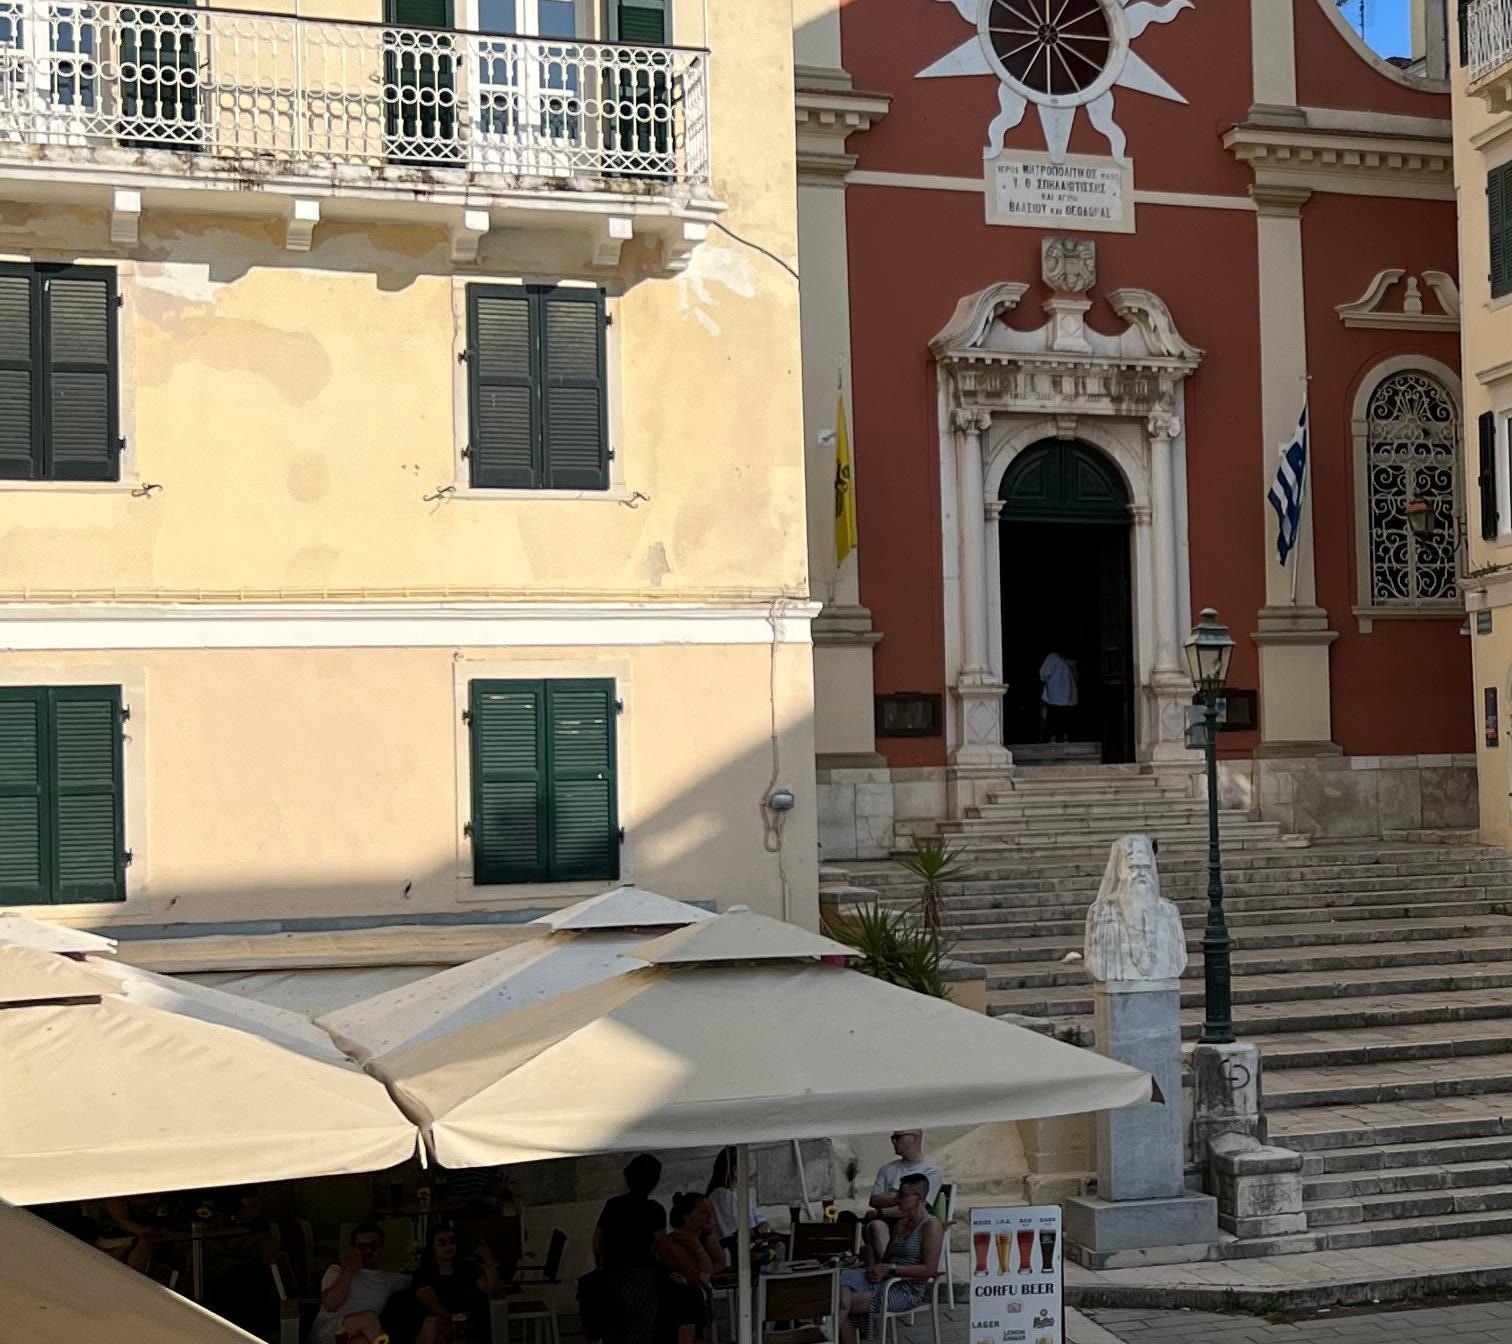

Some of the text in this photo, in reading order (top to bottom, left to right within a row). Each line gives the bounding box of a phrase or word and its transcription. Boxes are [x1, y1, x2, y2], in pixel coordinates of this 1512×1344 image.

[975, 1283, 1055, 1297] CORFU BEER
[972, 1321, 1000, 1329] LAGER
